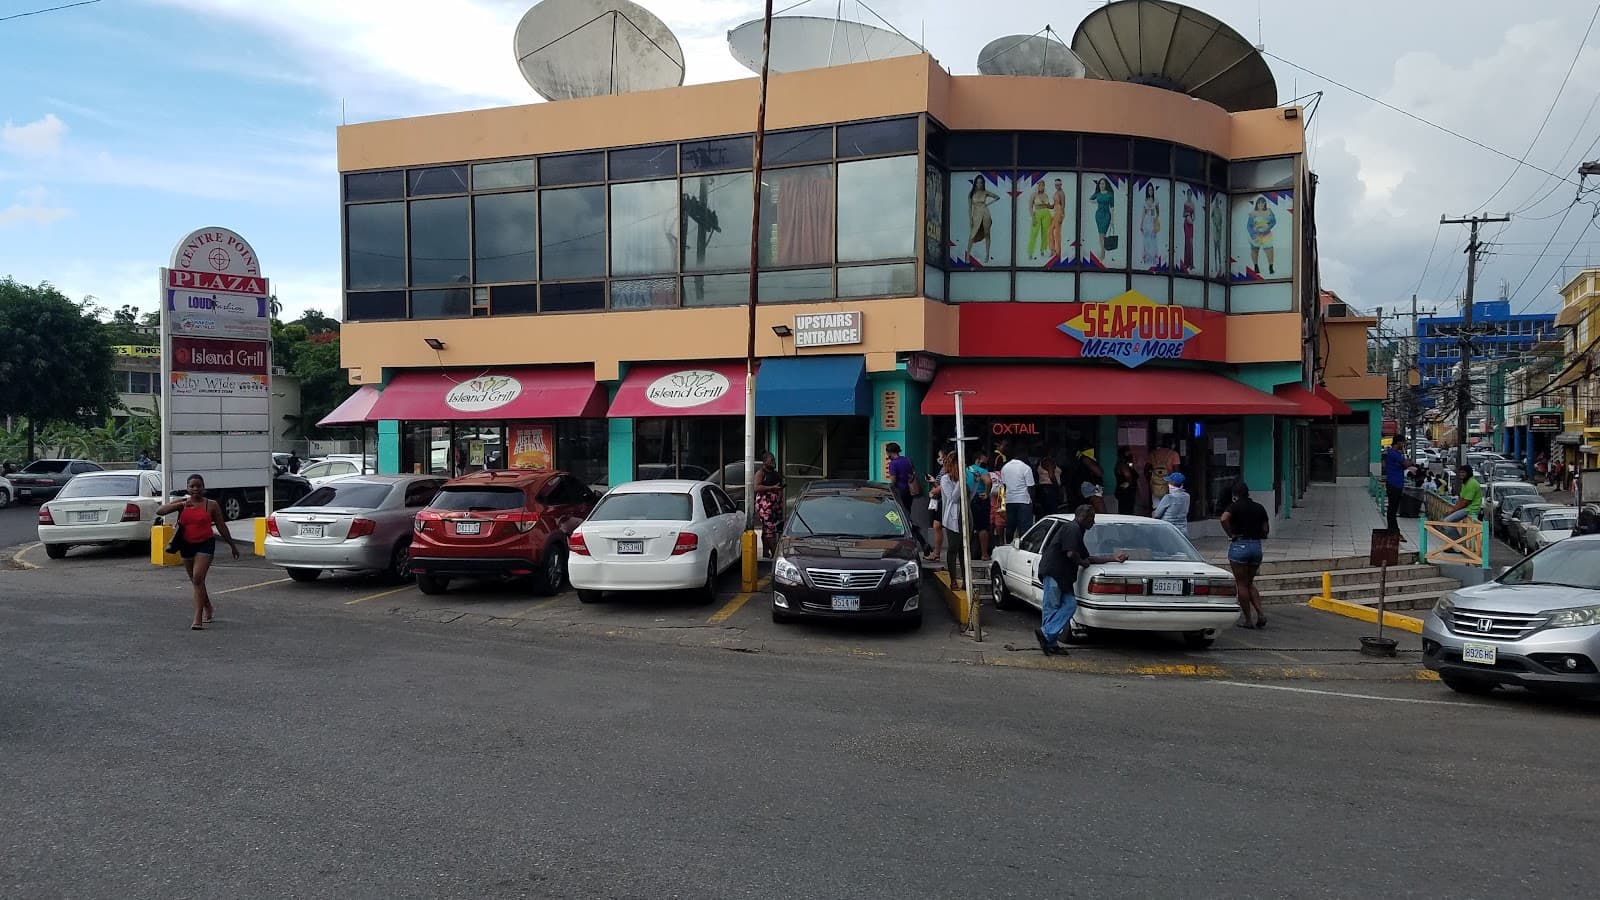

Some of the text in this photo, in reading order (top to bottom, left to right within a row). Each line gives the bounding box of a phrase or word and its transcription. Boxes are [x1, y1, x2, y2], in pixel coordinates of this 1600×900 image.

[180, 232, 256, 275] CENTRE POINT
[174, 272, 261, 292] PLAZA
[188, 296, 212, 309] LOUD
[796, 314, 852, 330] UPSTAIRS
[1082, 302, 1184, 339] SEAFOOD
[796, 328, 858, 345] ENTRANCE
[1081, 339, 1183, 358] MEATS & MORE
[191, 347, 264, 367] Island Grill
[175, 377, 199, 391] City
[648, 386, 723, 398] Island Grill
[448, 391, 516, 403] Island Grill
[992, 423, 1040, 435] OXTAIL
